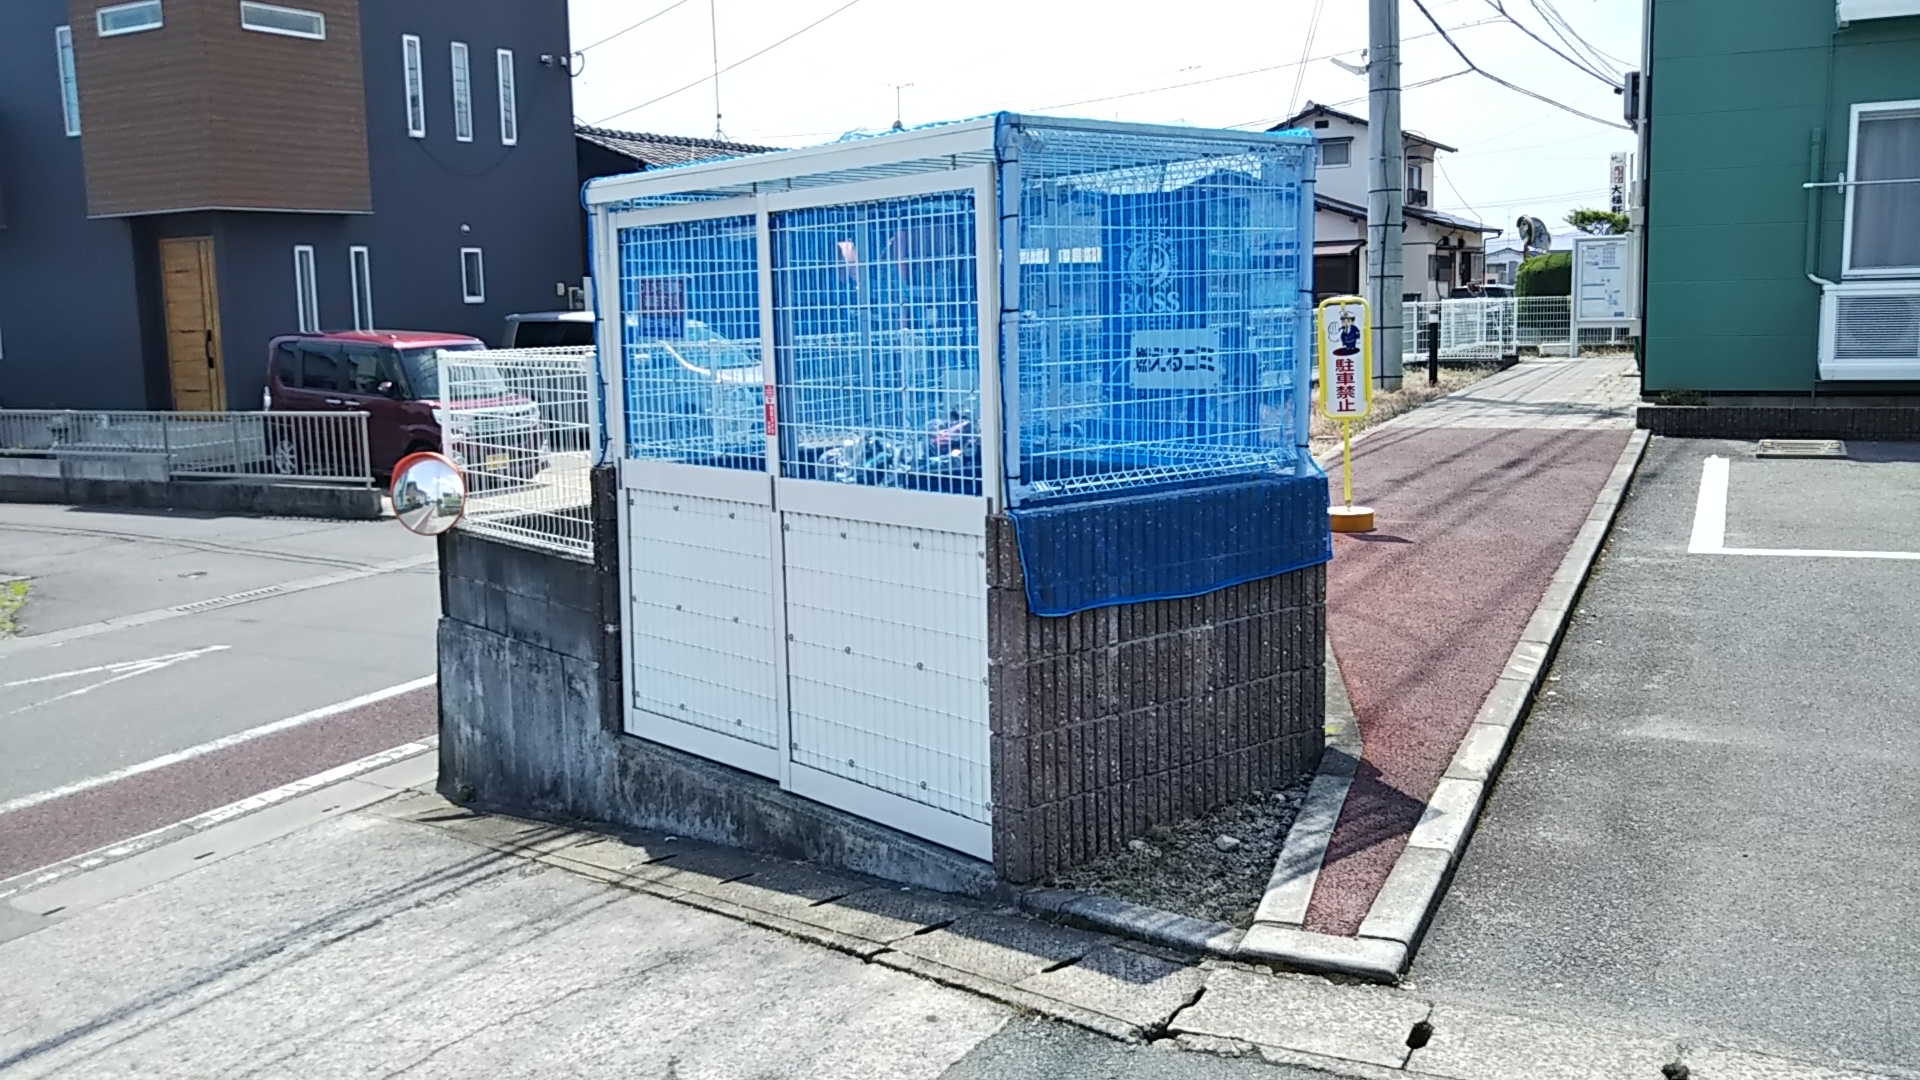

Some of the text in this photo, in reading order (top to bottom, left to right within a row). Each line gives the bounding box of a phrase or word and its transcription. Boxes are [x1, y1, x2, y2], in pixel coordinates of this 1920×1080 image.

[1118, 291, 1180, 313] BOSS
[1335, 358, 1356, 412] 駐車禁止
